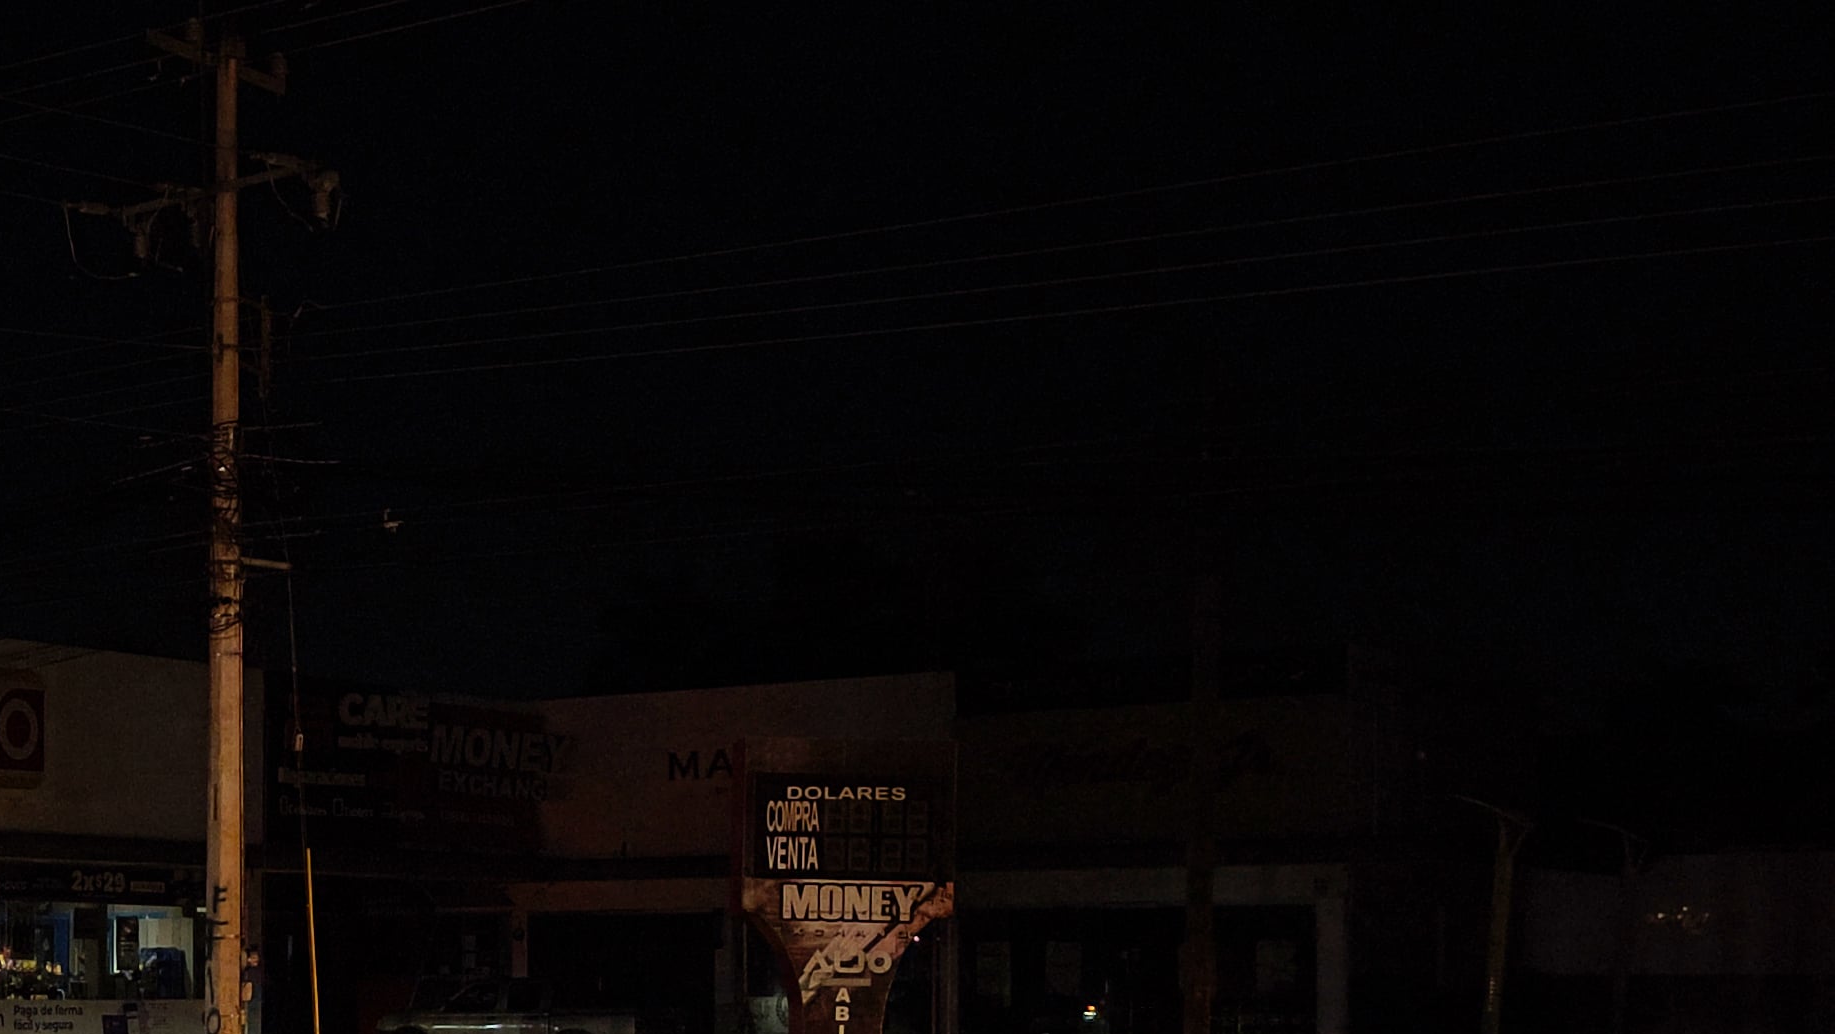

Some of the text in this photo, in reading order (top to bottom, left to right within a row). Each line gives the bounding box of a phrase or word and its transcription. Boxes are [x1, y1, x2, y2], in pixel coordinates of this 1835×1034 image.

[338, 691, 429, 729] CARE
[429, 723, 571, 774] MONEY
[786, 785, 907, 802] DOLARES
[766, 800, 820, 833] COMPRA
[766, 836, 820, 871] VENTA
[781, 883, 923, 922] MONEY
[13, 1004, 83, 1019] Paga de forma
